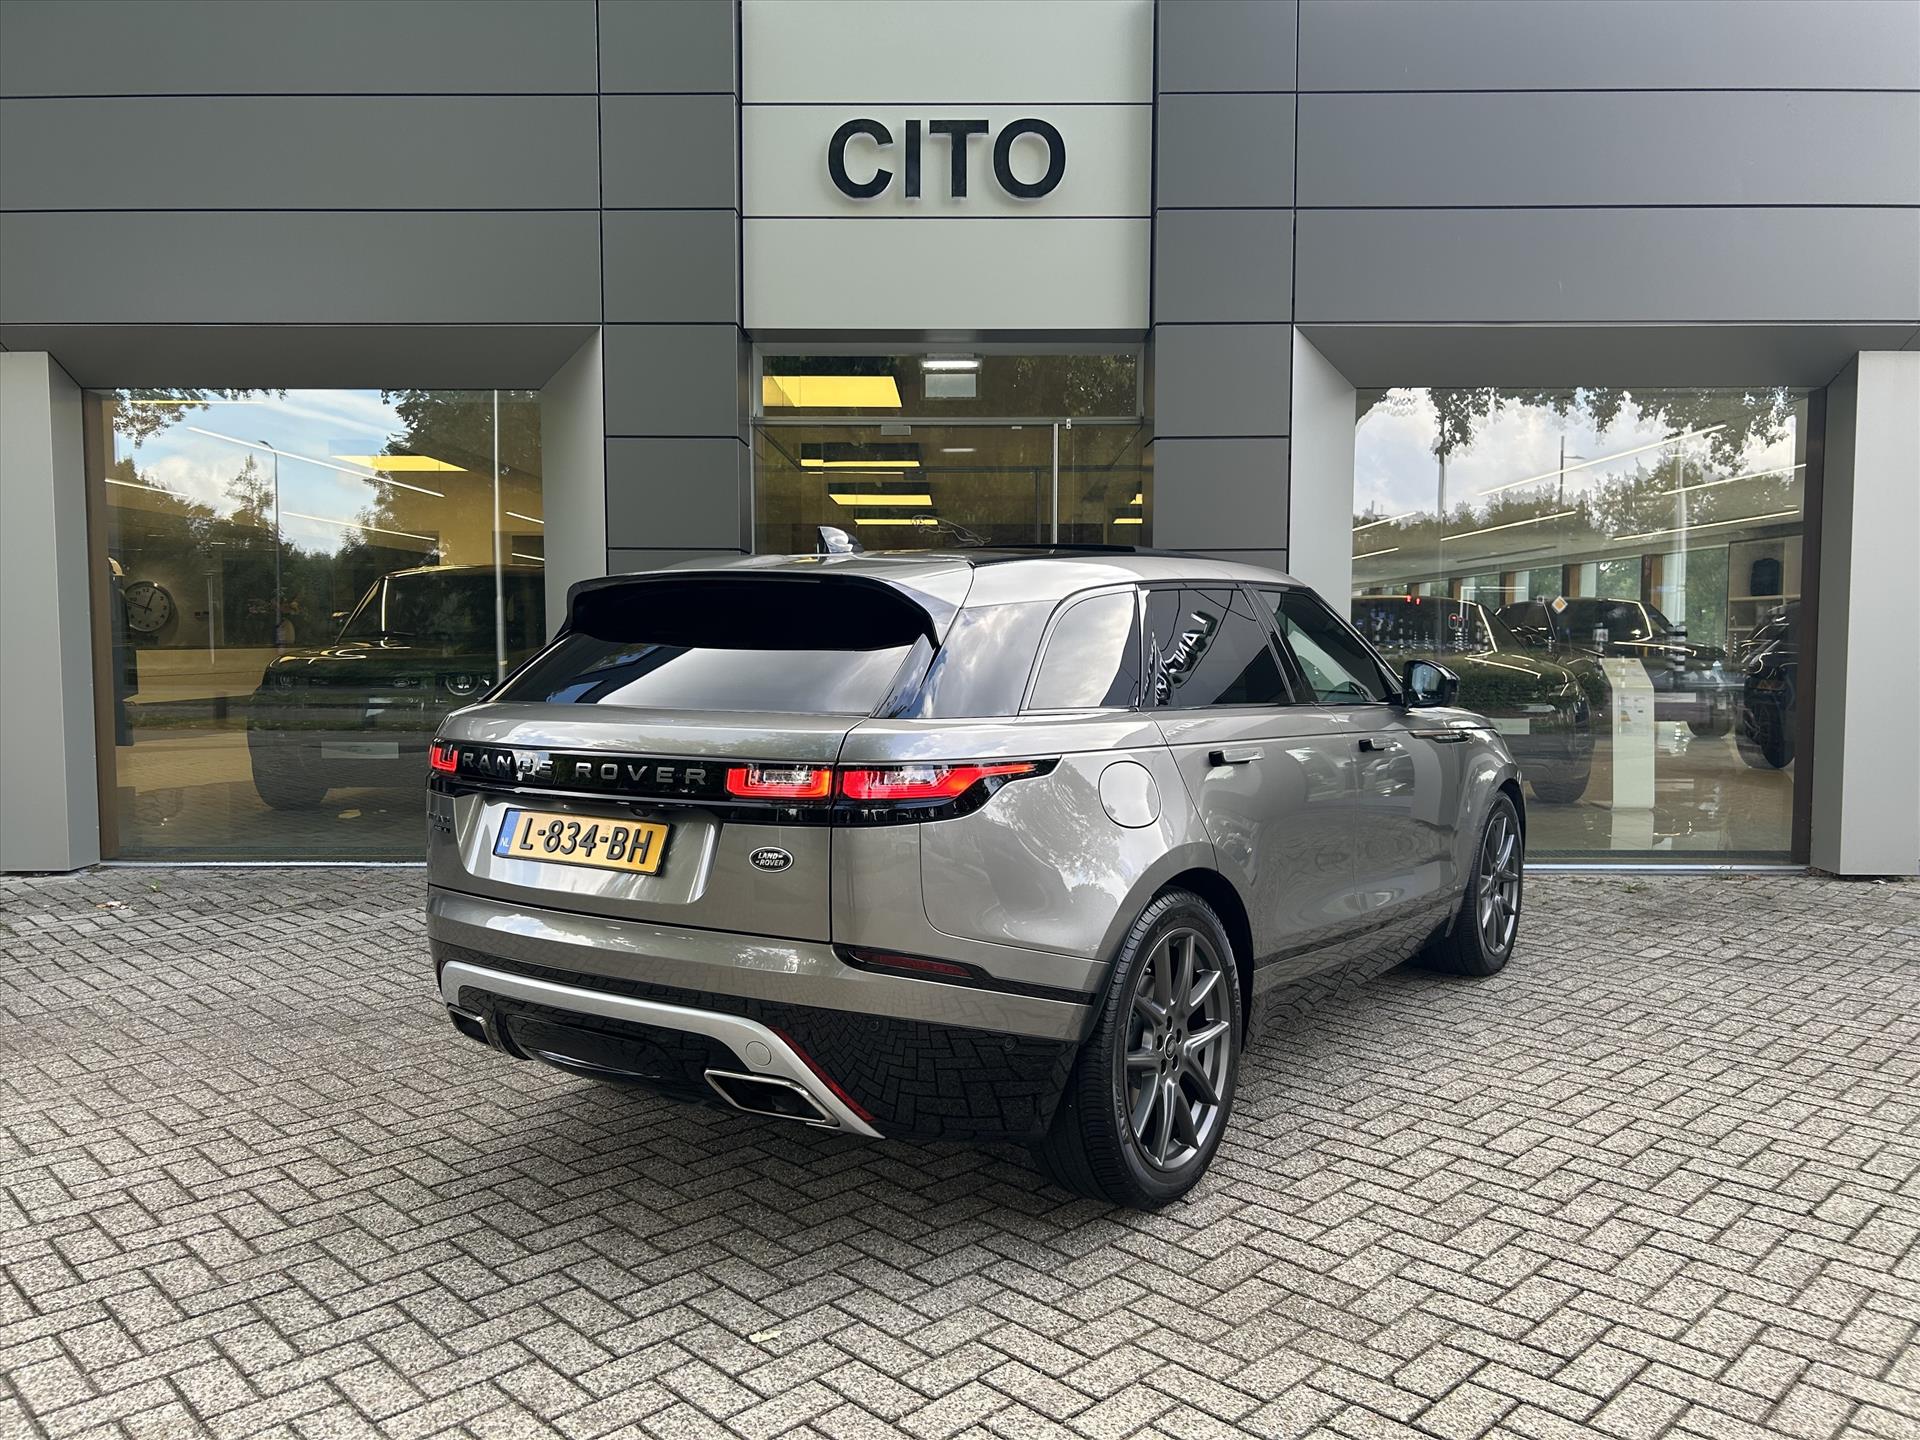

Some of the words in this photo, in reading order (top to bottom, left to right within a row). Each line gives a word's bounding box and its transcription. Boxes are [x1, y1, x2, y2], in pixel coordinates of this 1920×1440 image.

[828, 118, 1066, 199] CITO
[462, 752, 554, 775] RANGE
[575, 762, 706, 785] ROVER
[501, 836, 510, 848] NL
[519, 817, 653, 864] L-834-BH
